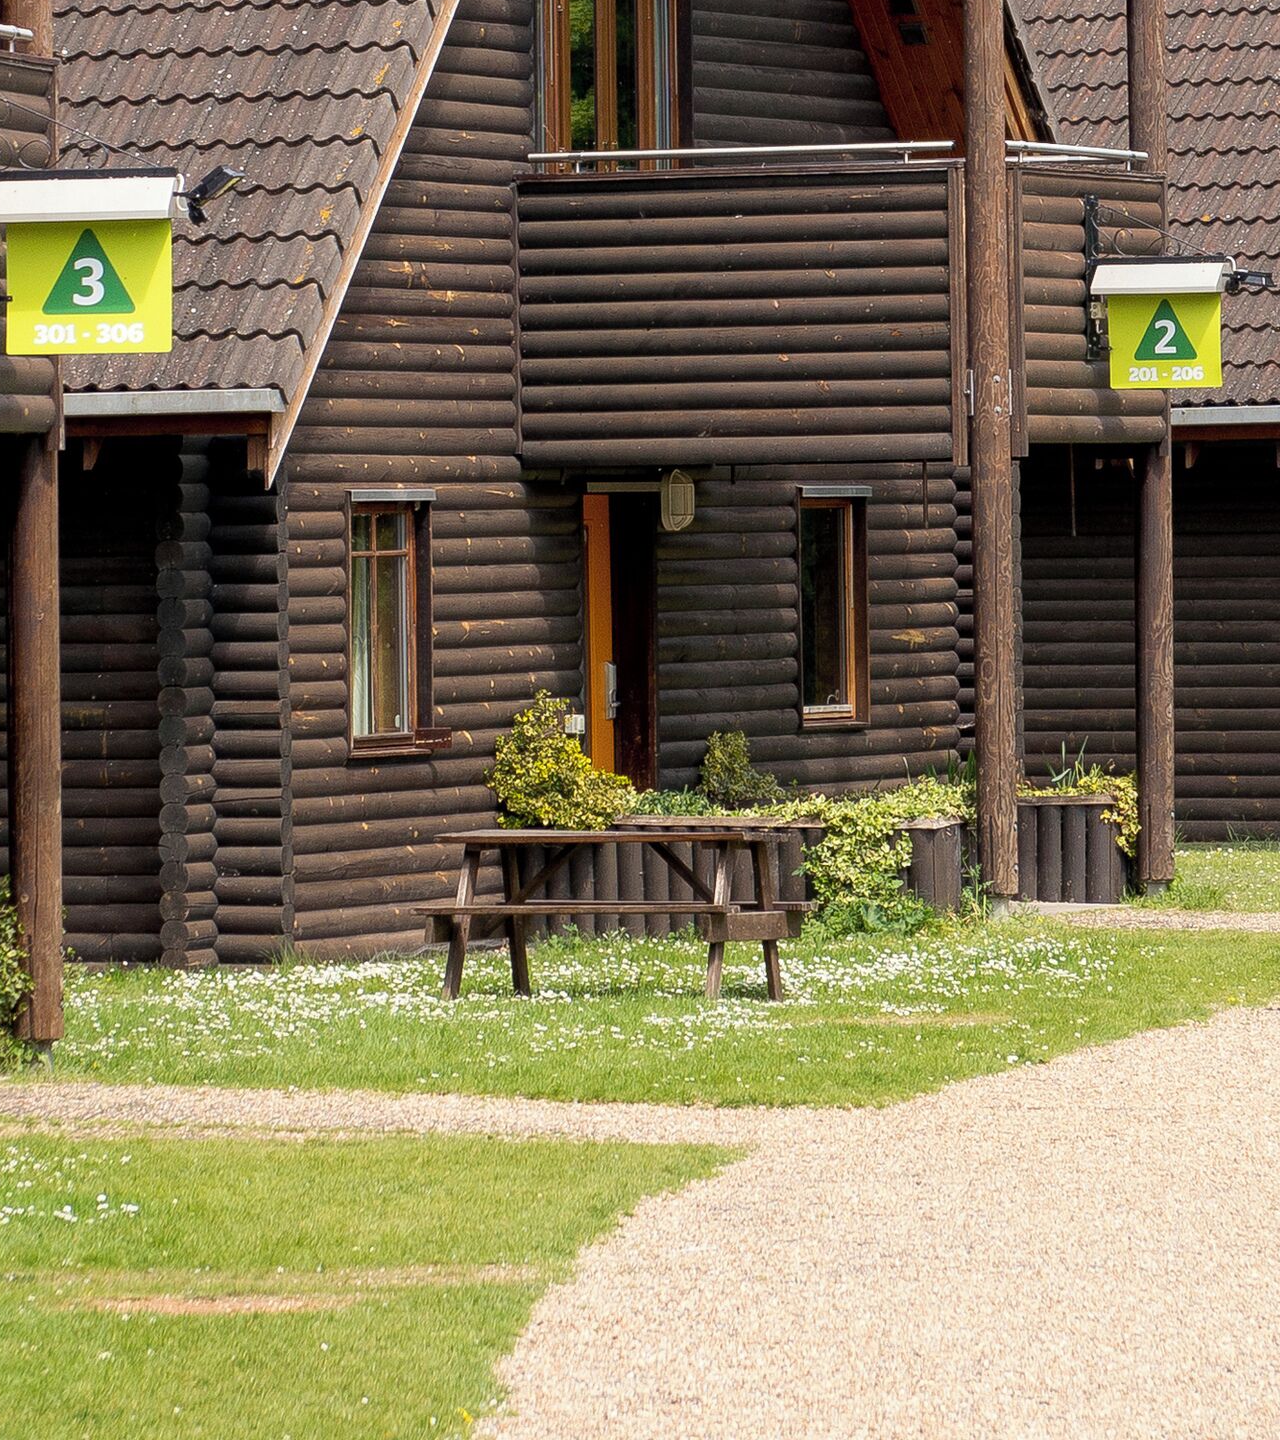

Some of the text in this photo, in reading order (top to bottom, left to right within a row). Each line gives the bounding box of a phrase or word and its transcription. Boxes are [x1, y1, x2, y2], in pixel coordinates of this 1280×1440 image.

[72, 257, 105, 306] 3
[33, 323, 76, 344] 301
[96, 322, 144, 343] 306
[1154, 319, 1177, 354] 2
[1128, 367, 1158, 382] 201
[1171, 366, 1204, 381] 206
